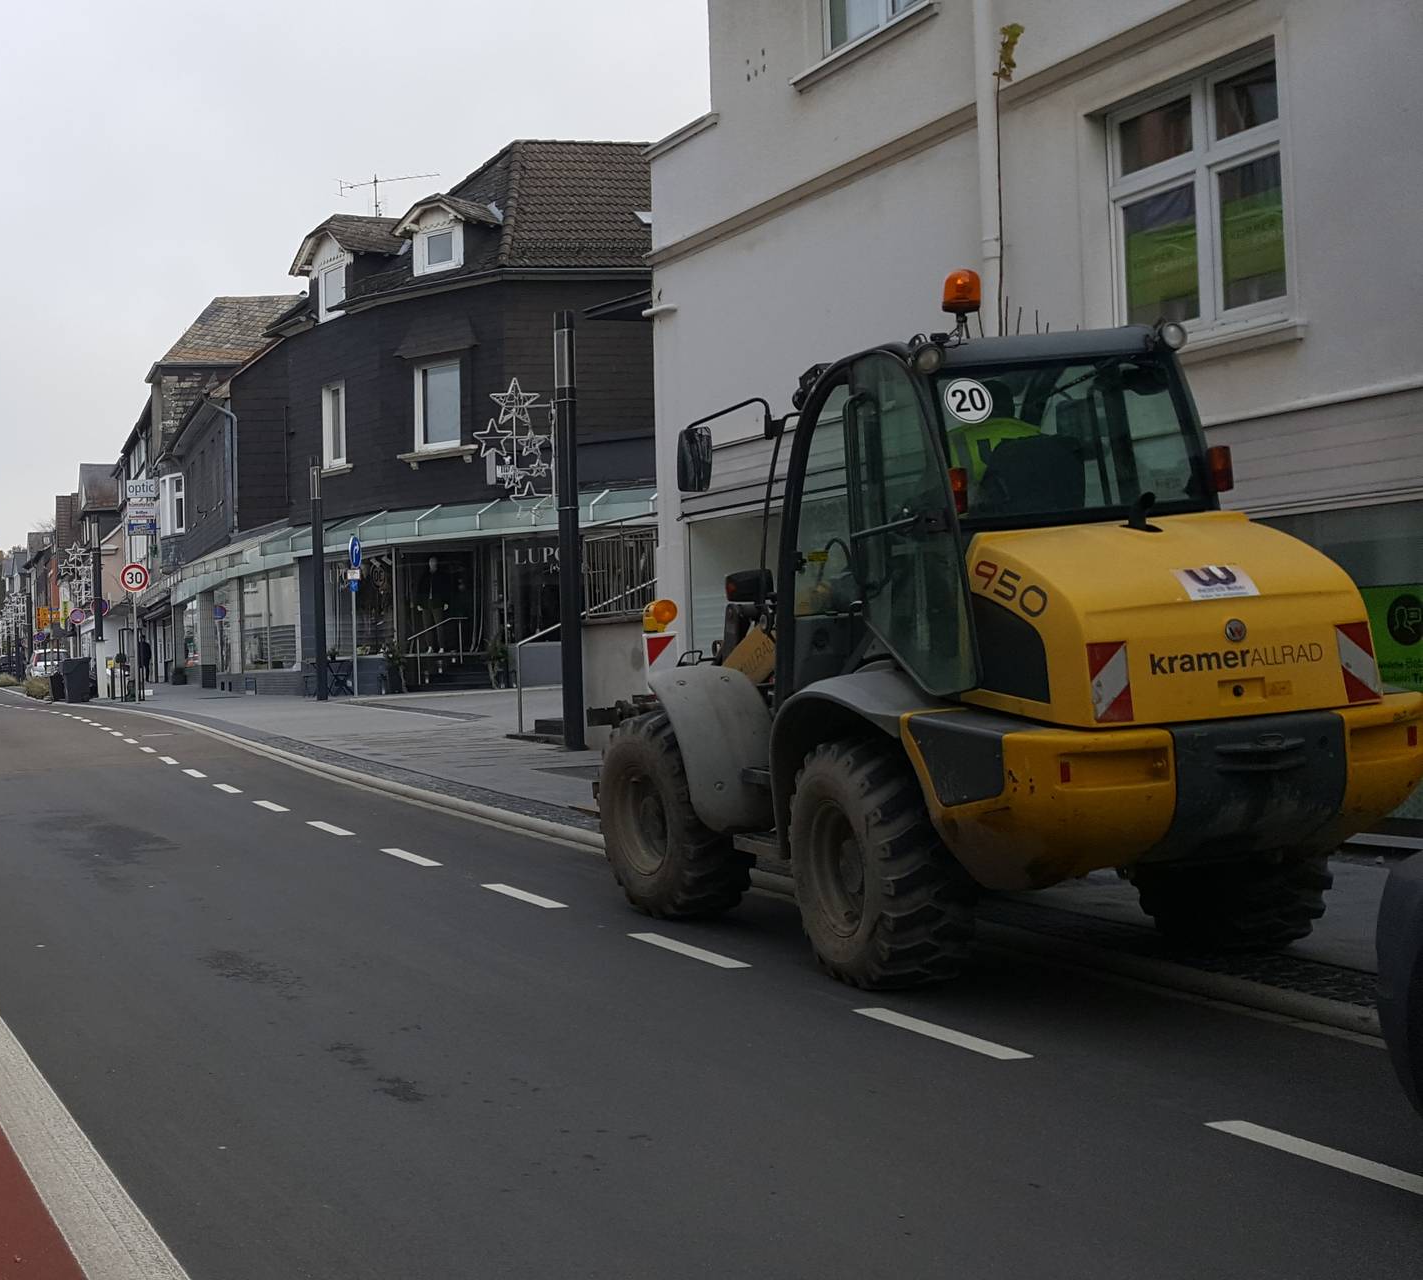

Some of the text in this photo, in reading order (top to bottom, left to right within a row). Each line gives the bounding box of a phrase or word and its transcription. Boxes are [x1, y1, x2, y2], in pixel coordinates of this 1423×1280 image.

[951, 388, 987, 413] 20
[128, 482, 154, 495] optic
[127, 572, 143, 584] 30
[975, 560, 1048, 618] 950
